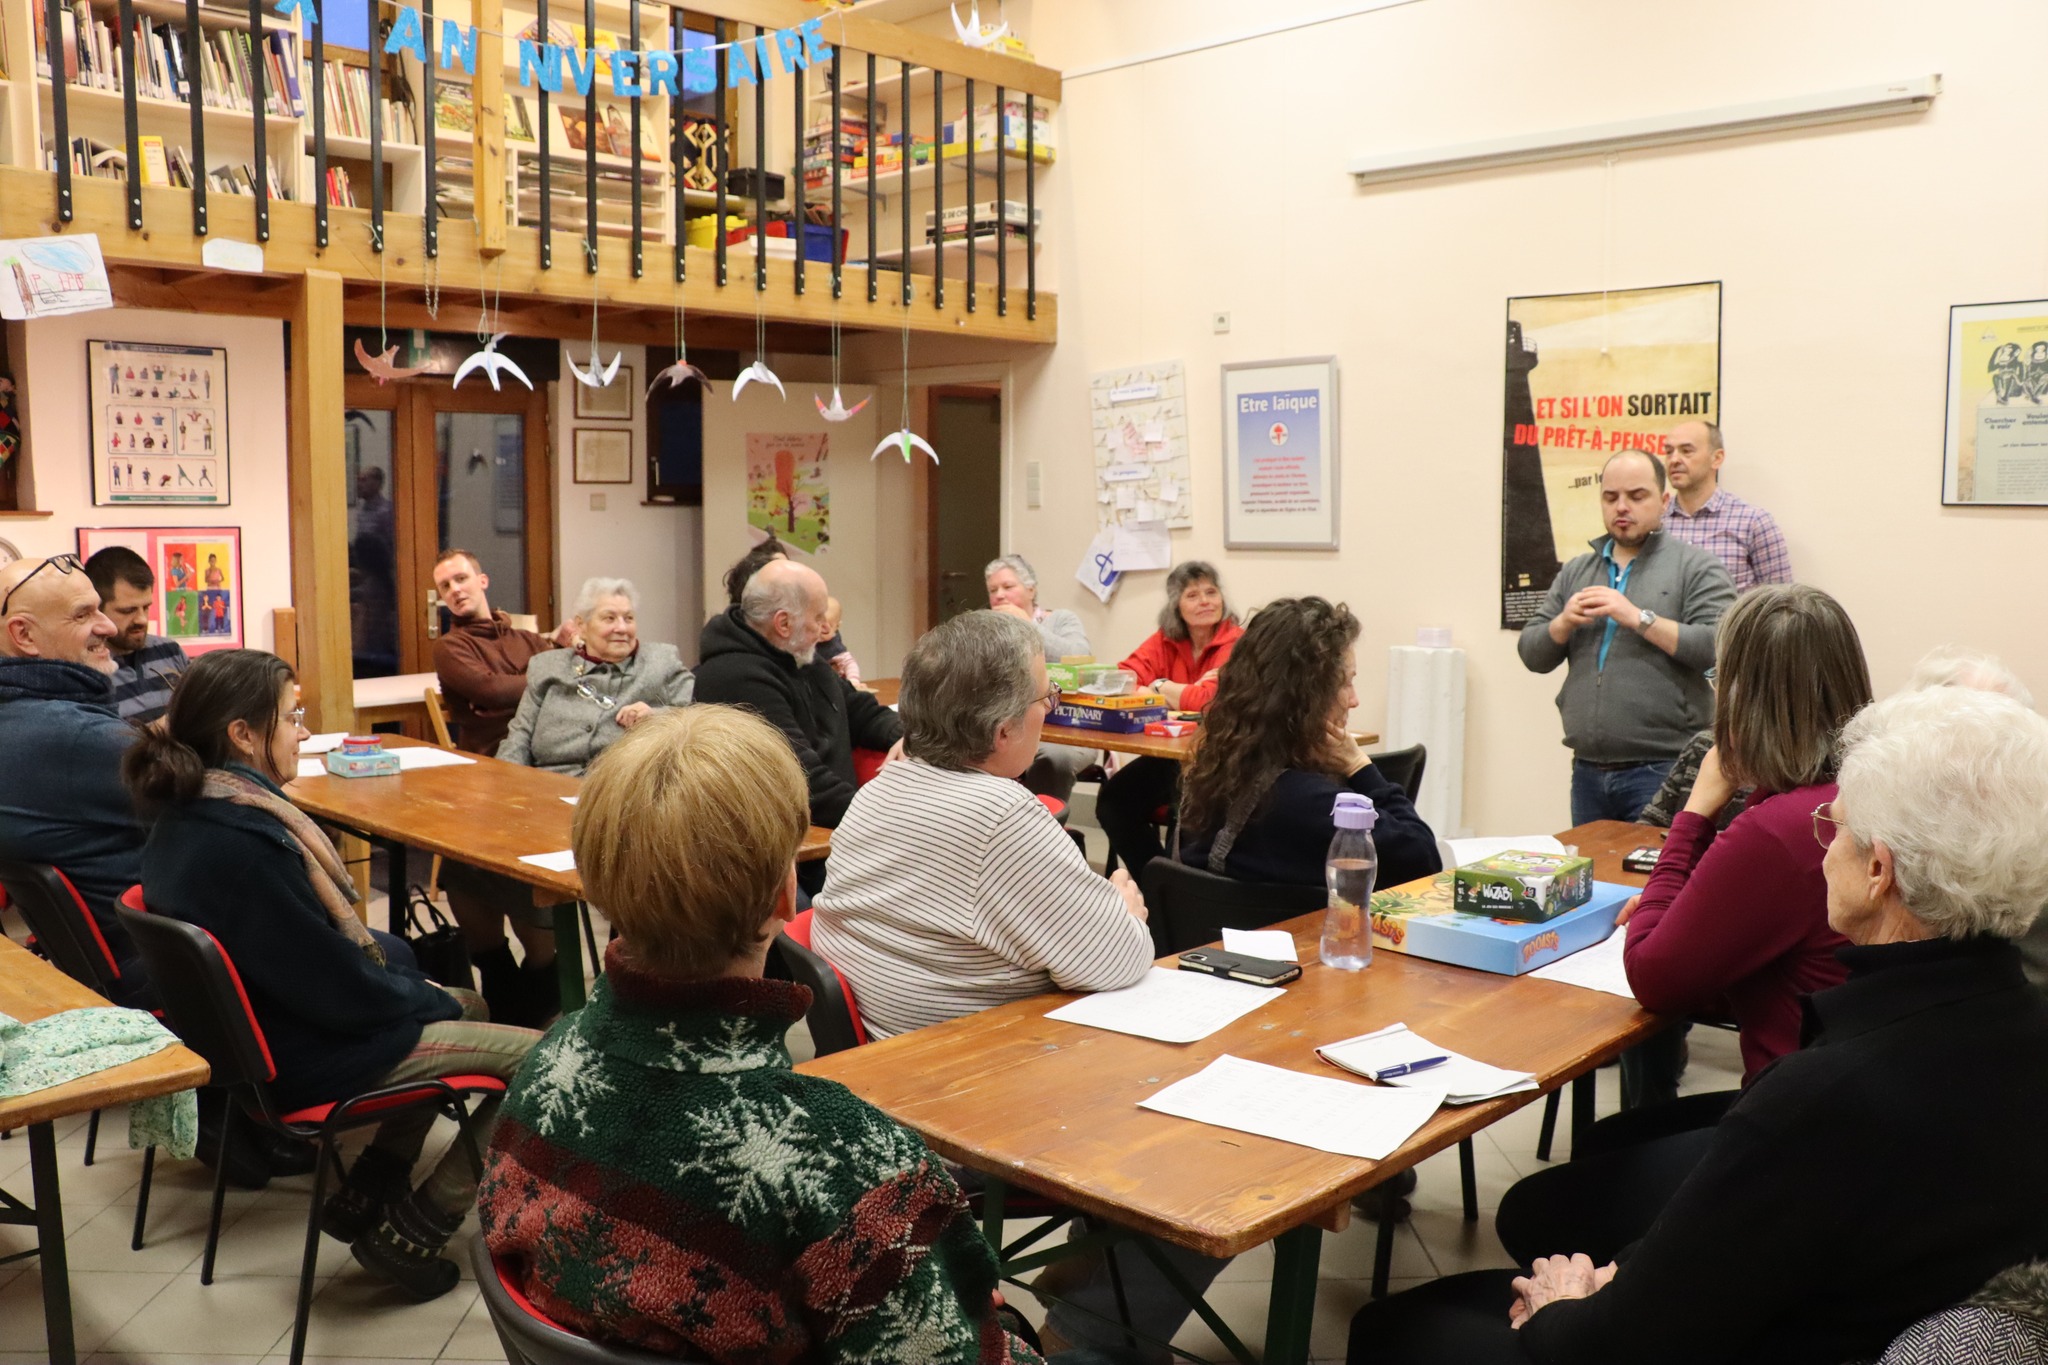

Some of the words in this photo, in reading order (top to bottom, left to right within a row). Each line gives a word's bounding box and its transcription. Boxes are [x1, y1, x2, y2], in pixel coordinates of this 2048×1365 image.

[1240, 396, 1269, 413] Etre
[1273, 393, 1317, 414] laïque
[1536, 397, 1556, 419] ET
[1560, 397, 1578, 419] SI
[1583, 395, 1623, 418] L'ON
[1628, 392, 1711, 417] SORTAIT
[1514, 424, 1538, 446] DU
[1542, 423, 1668, 456] PRÊT-À-PENSE
[1054, 705, 1104, 721] PICTIONARY
[1370, 913, 1406, 945] ASiS
